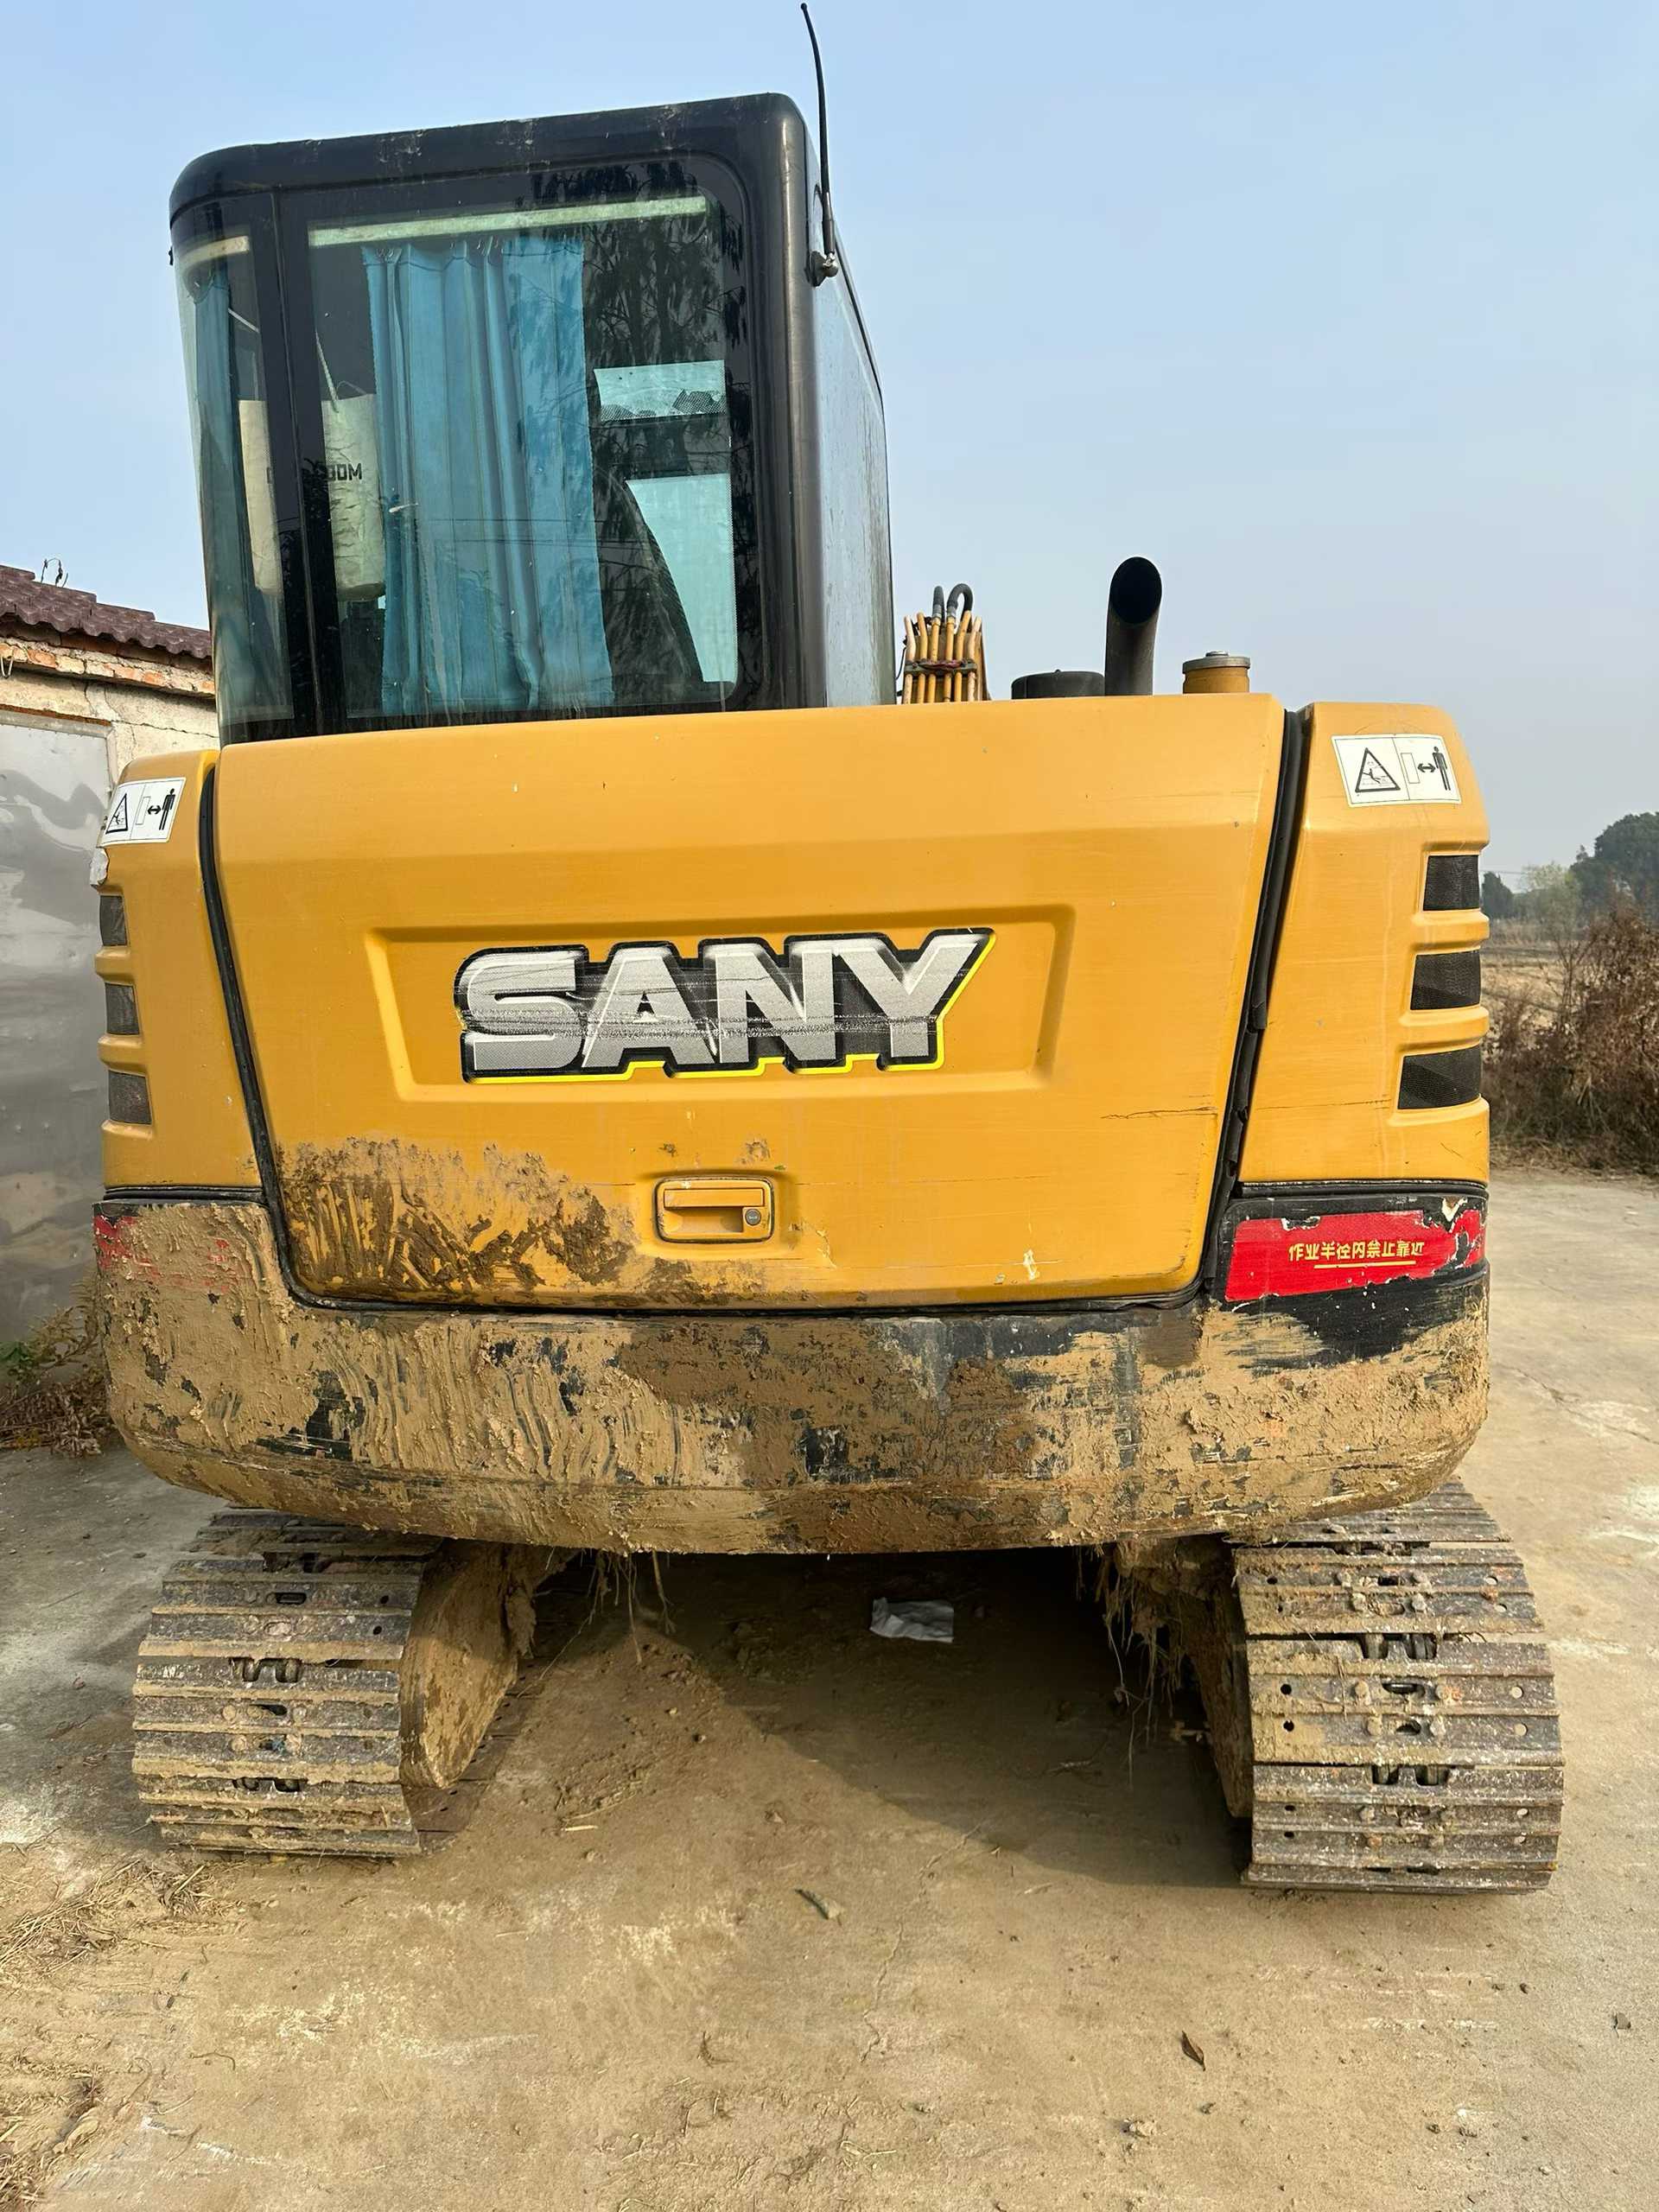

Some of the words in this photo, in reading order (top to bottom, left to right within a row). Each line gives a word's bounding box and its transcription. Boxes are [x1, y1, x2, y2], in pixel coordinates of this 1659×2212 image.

[455, 930, 990, 1080] SANY
[1287, 1238, 1426, 1262] 作业半径内禁止靠近
